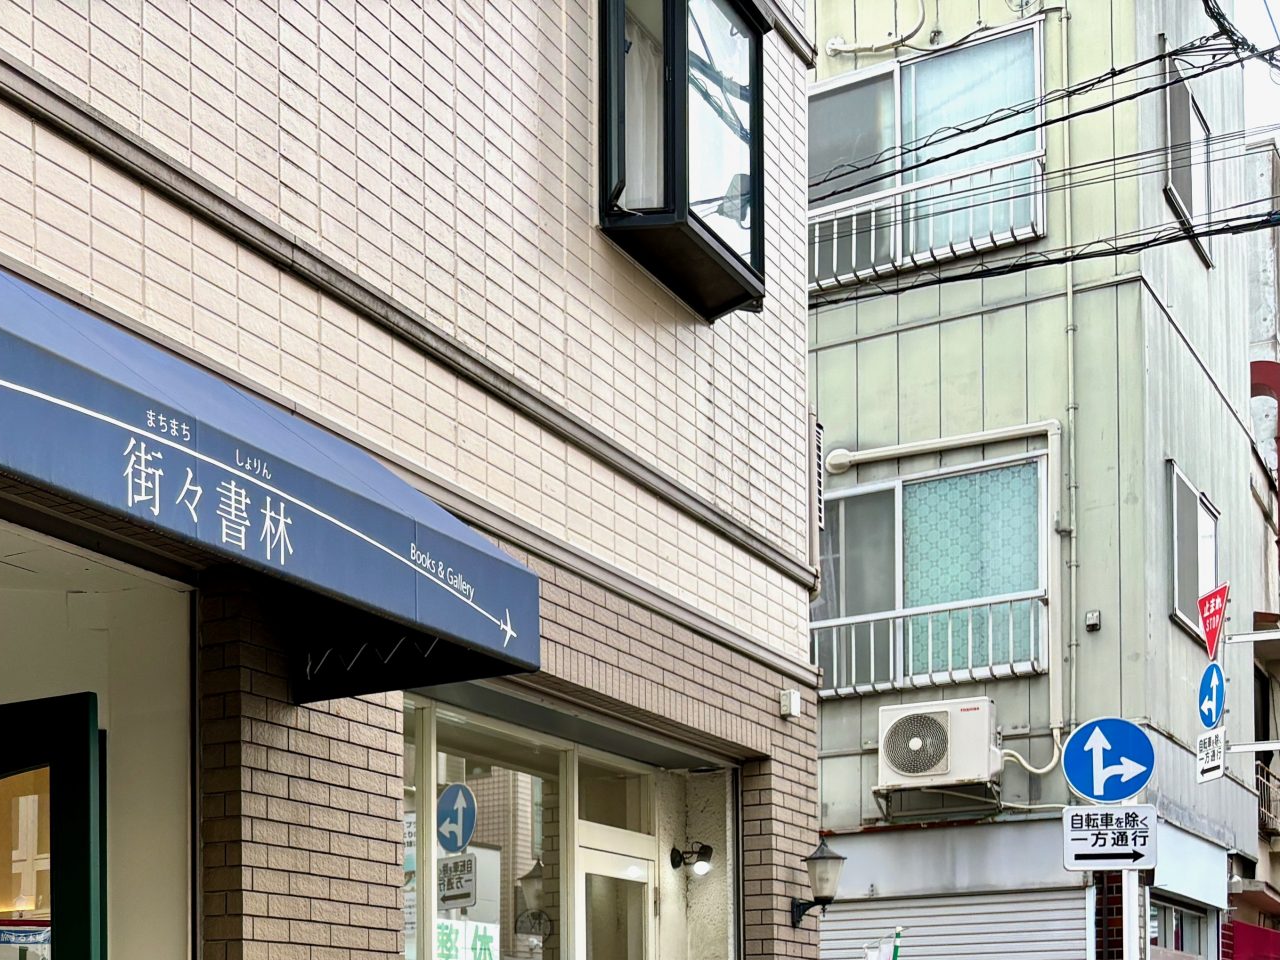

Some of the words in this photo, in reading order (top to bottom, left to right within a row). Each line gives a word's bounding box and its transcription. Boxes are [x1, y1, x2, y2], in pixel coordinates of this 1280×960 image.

[146, 409, 191, 441] まちまち
[235, 449, 272, 480] しょりん
[123, 437, 294, 566] 街々書林
[410, 542, 436, 573] Books
[437, 561, 445, 579] &
[446, 567, 475, 602] Gallery
[1203, 594, 1222, 617] 止まれ
[1205, 614, 1220, 632] STOP
[1198, 748, 1222, 764] 一方通行
[1070, 811, 1149, 829] 自転車を除く
[1070, 830, 1149, 848] 一方通行
